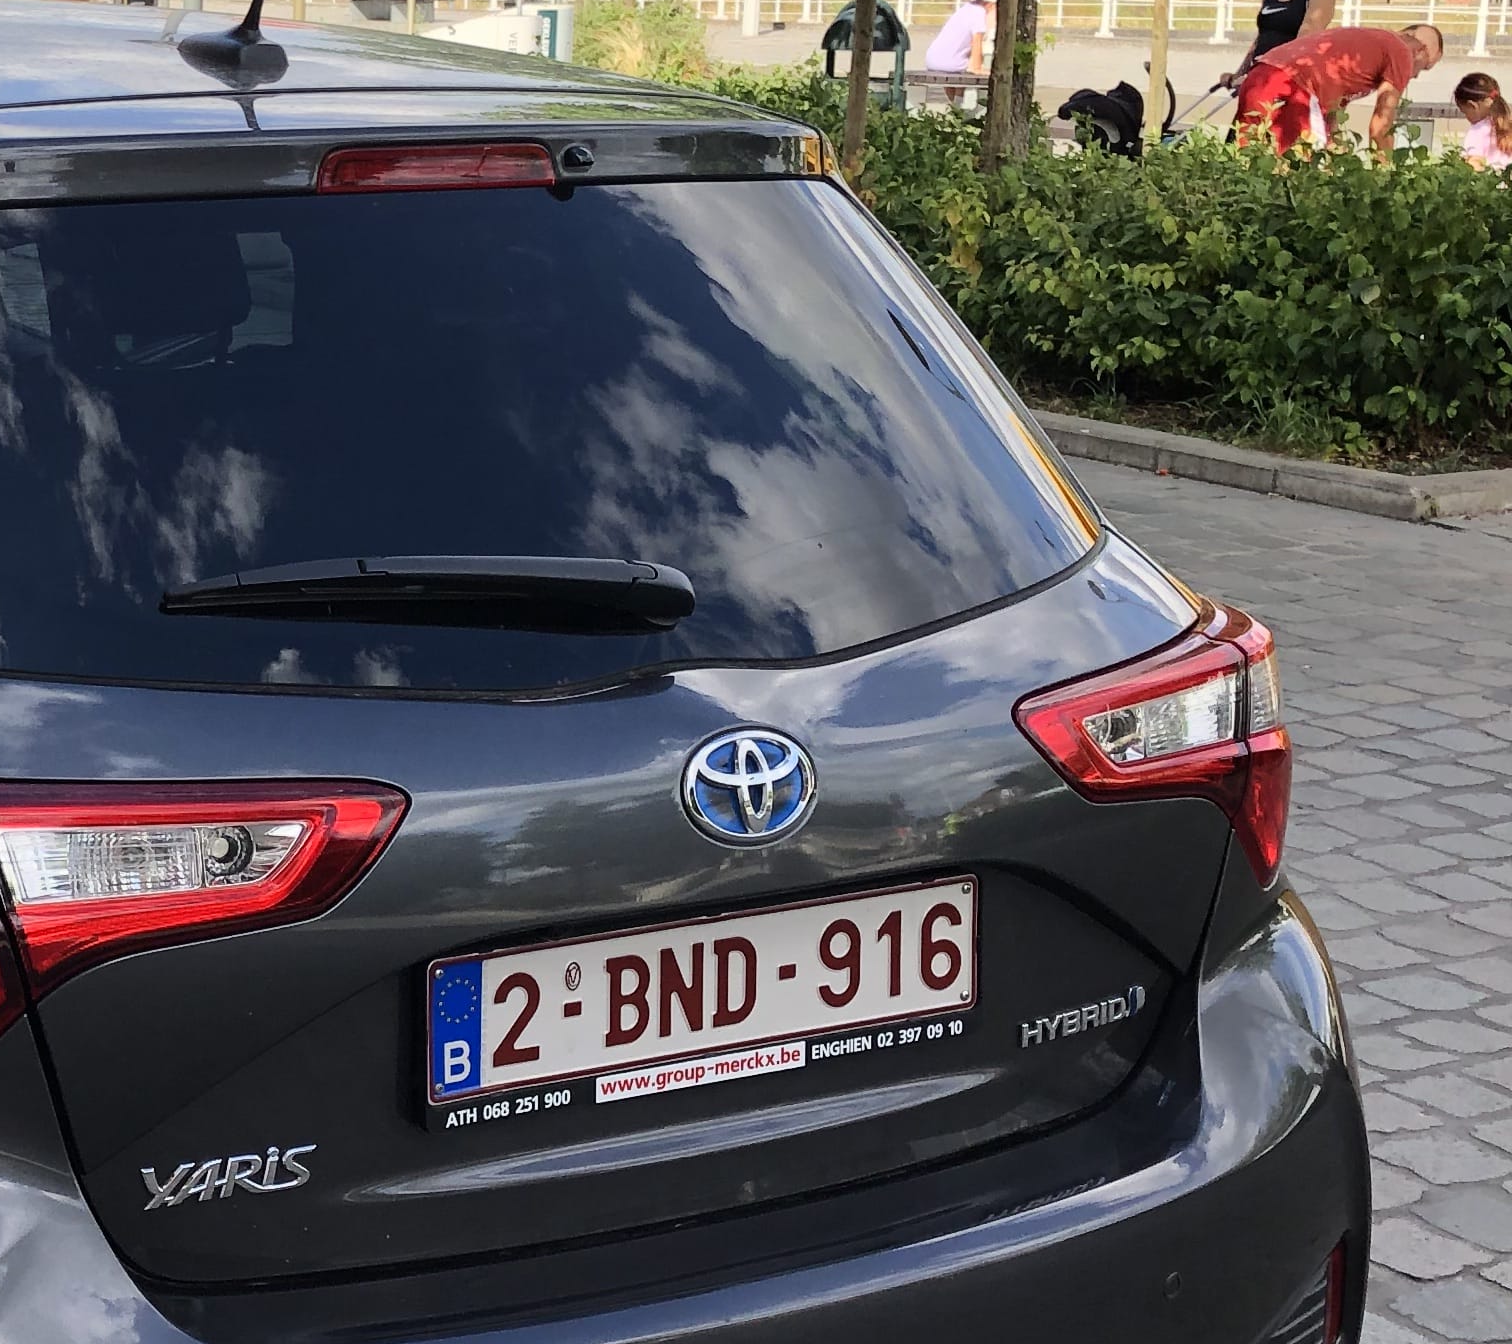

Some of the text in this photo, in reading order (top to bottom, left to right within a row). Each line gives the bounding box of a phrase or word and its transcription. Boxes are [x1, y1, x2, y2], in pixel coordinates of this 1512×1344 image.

[492, 902, 962, 1068] 2-BND-916
[811, 1019, 963, 1060] ENGHIEN 02 397 09 10
[1021, 997, 1127, 1048] HYBRID
[443, 1040, 471, 1084] B
[600, 1047, 801, 1096] www.group-merckx.be
[445, 1089, 571, 1129] ATH 068 251 900
